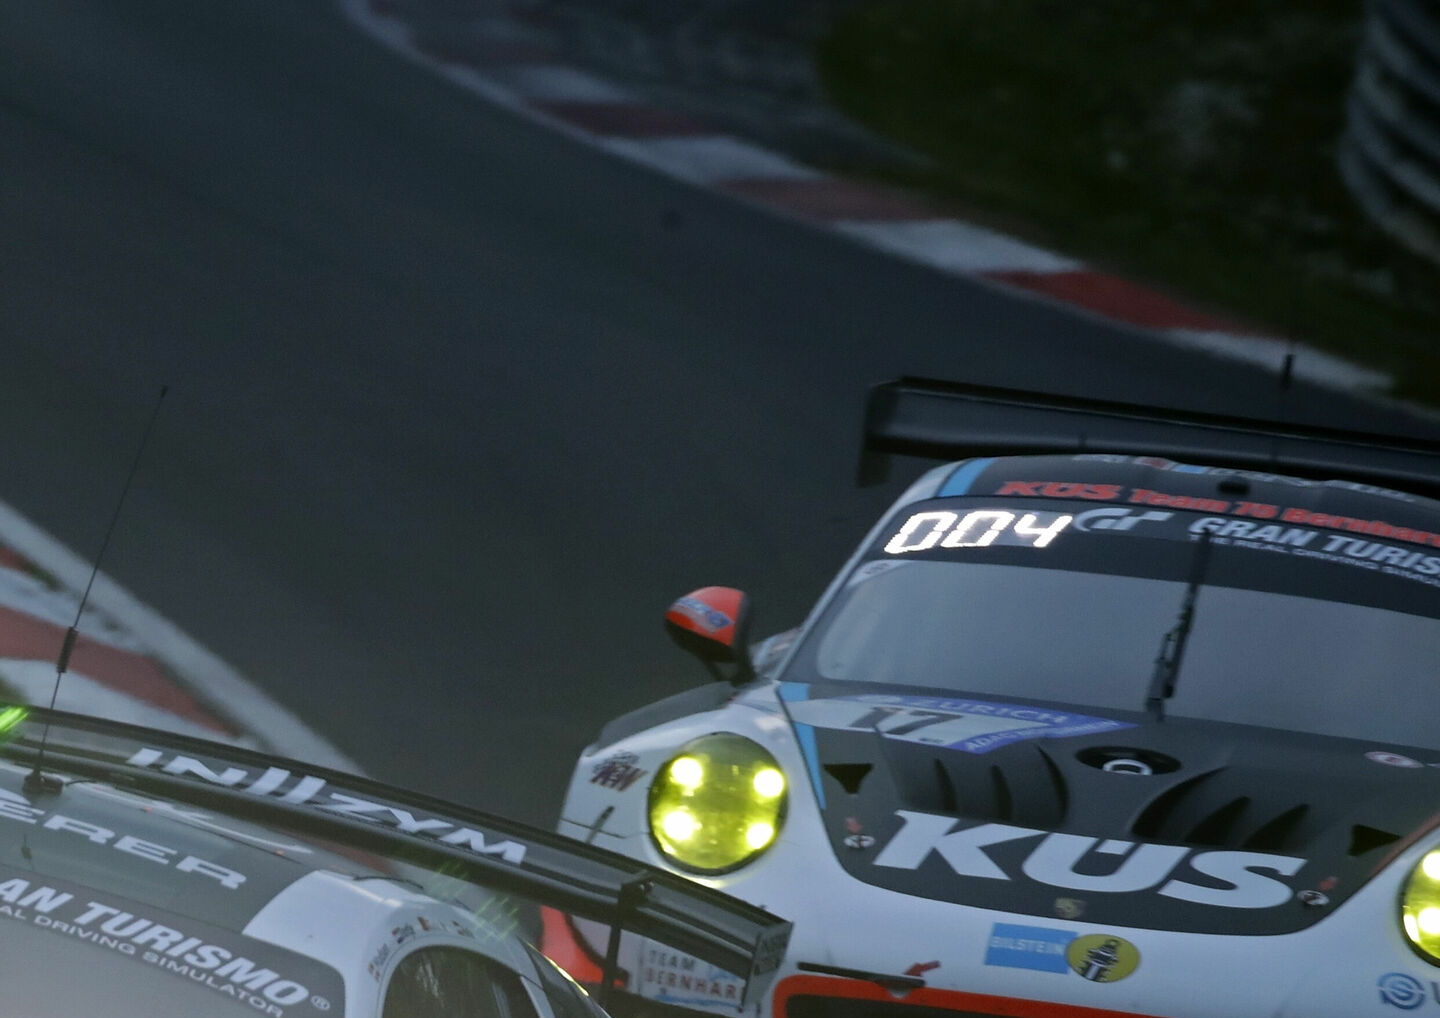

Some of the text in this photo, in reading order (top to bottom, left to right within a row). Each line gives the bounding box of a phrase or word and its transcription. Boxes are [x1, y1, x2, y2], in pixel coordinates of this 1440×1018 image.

[1128, 488, 1228, 513] Team
[1230, 500, 1278, 519] 75
[883, 510, 1072, 554] 004
[1187, 516, 1319, 548] GRAN
[1321, 534, 1440, 577] TURIS
[73, 901, 312, 1006] TURISMO
[649, 949, 696, 973] TEAM
[990, 934, 1066, 956] BILSTEIN
[33, 914, 136, 957] DRIVING
[142, 951, 284, 1018] SIMULATOR
[645, 966, 746, 1000] BERNHAR
